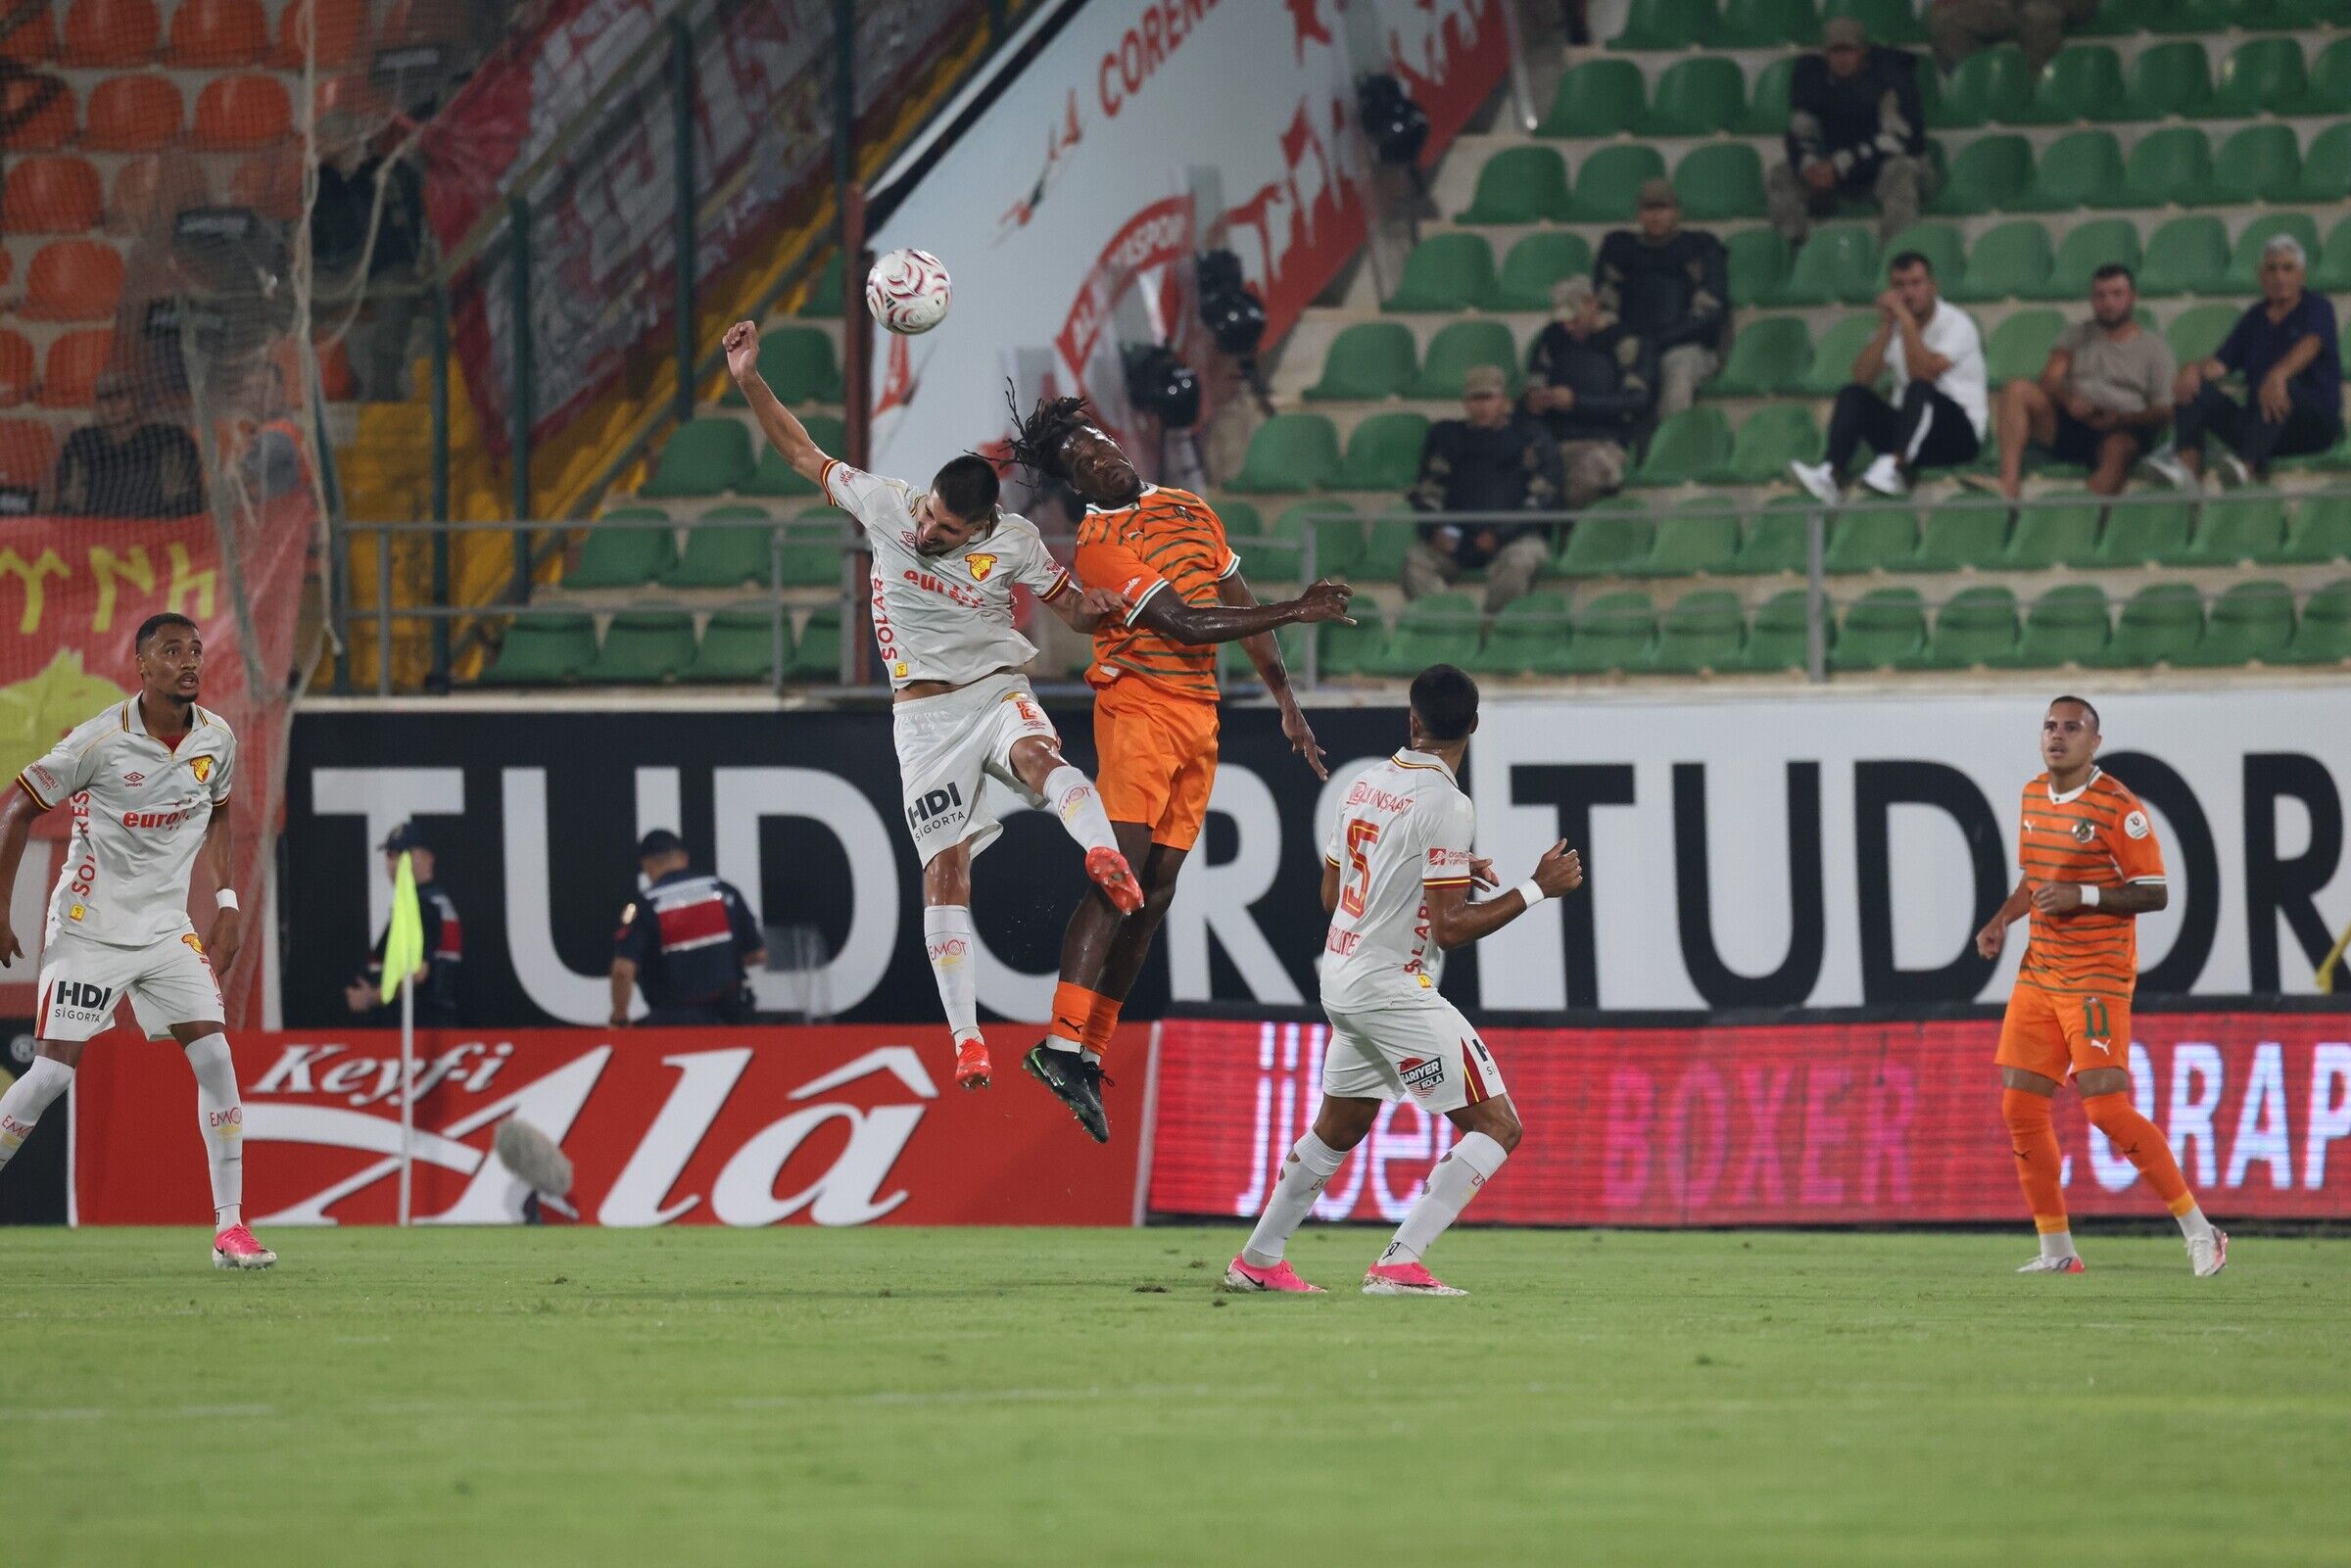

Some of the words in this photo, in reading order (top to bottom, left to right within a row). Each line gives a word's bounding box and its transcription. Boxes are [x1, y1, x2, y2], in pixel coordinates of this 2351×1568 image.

[1099, 0, 1219, 118] COREN
[907, 782, 963, 831] HDI
[1341, 818, 1379, 920] 5
[56, 980, 113, 1011] HDI
[2084, 1002, 2111, 1038] 11
[251, 1042, 515, 1107] Keyfi
[1421, 1074, 1444, 1089] KOLA
[1603, 1061, 1917, 1210] BOXER
[2057, 1041, 2351, 1192] ORAP
